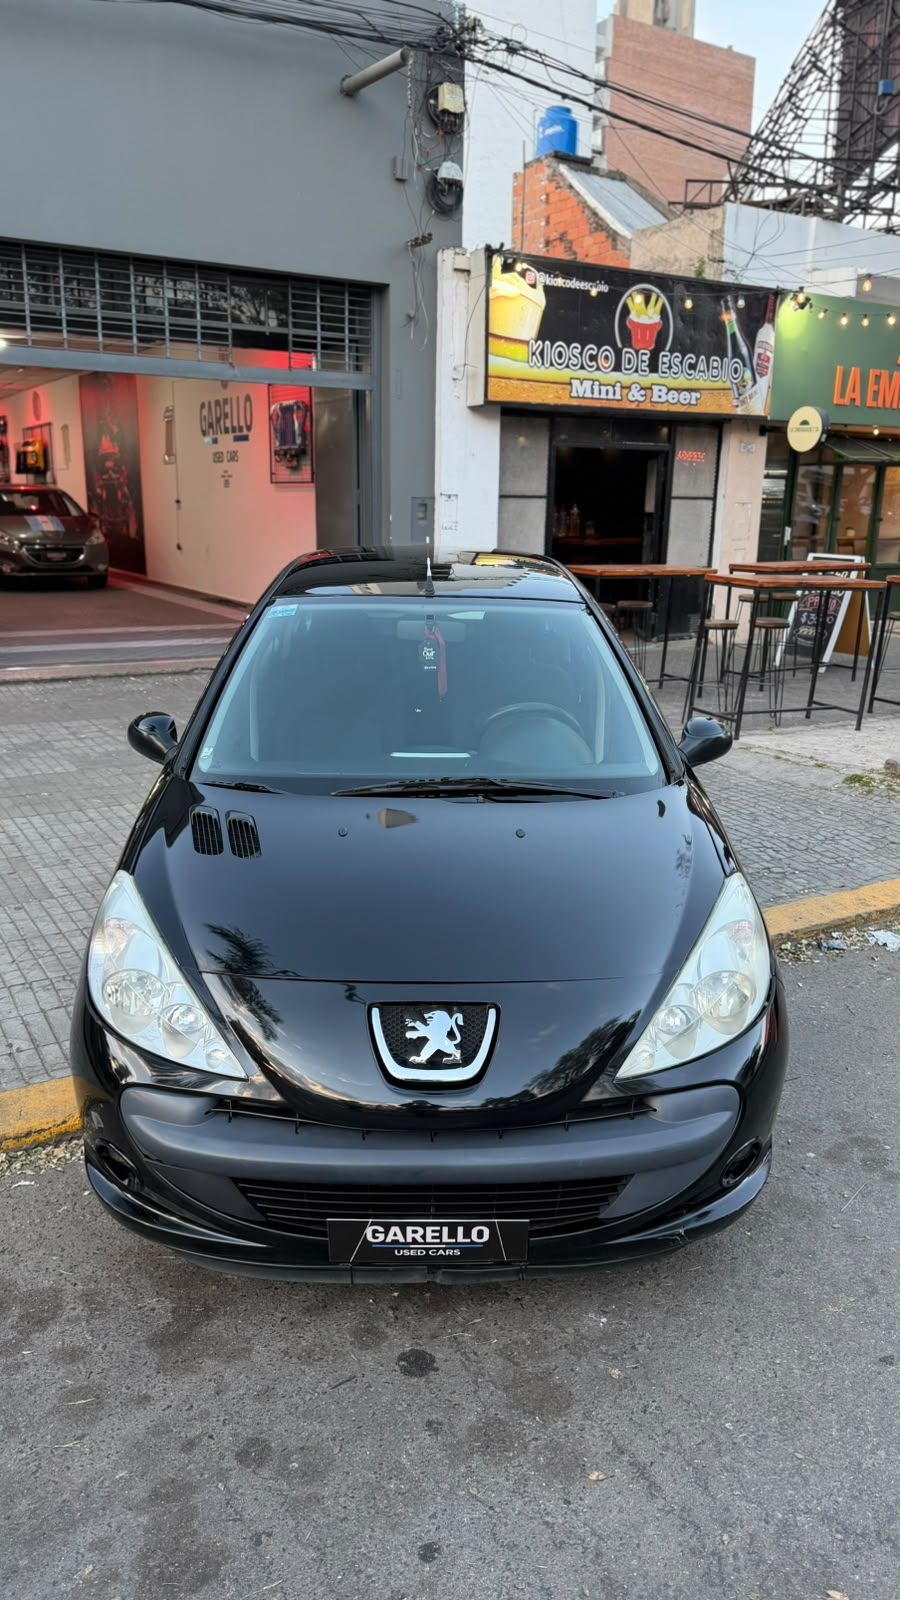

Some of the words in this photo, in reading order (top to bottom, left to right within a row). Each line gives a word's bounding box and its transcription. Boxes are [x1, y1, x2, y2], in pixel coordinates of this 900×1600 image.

[538, 271, 609, 293] @kioscodeescbio
[528, 339, 615, 373] KIOSCO
[622, 347, 651, 376] DE
[659, 351, 744, 384] ESCABIO
[570, 378, 622, 400] Mini
[627, 382, 646, 402] &
[651, 384, 700, 405] Beer
[833, 365, 861, 406] LA
[200, 394, 253, 437] GARELLO
[365, 1225, 490, 1243] GARELLO
